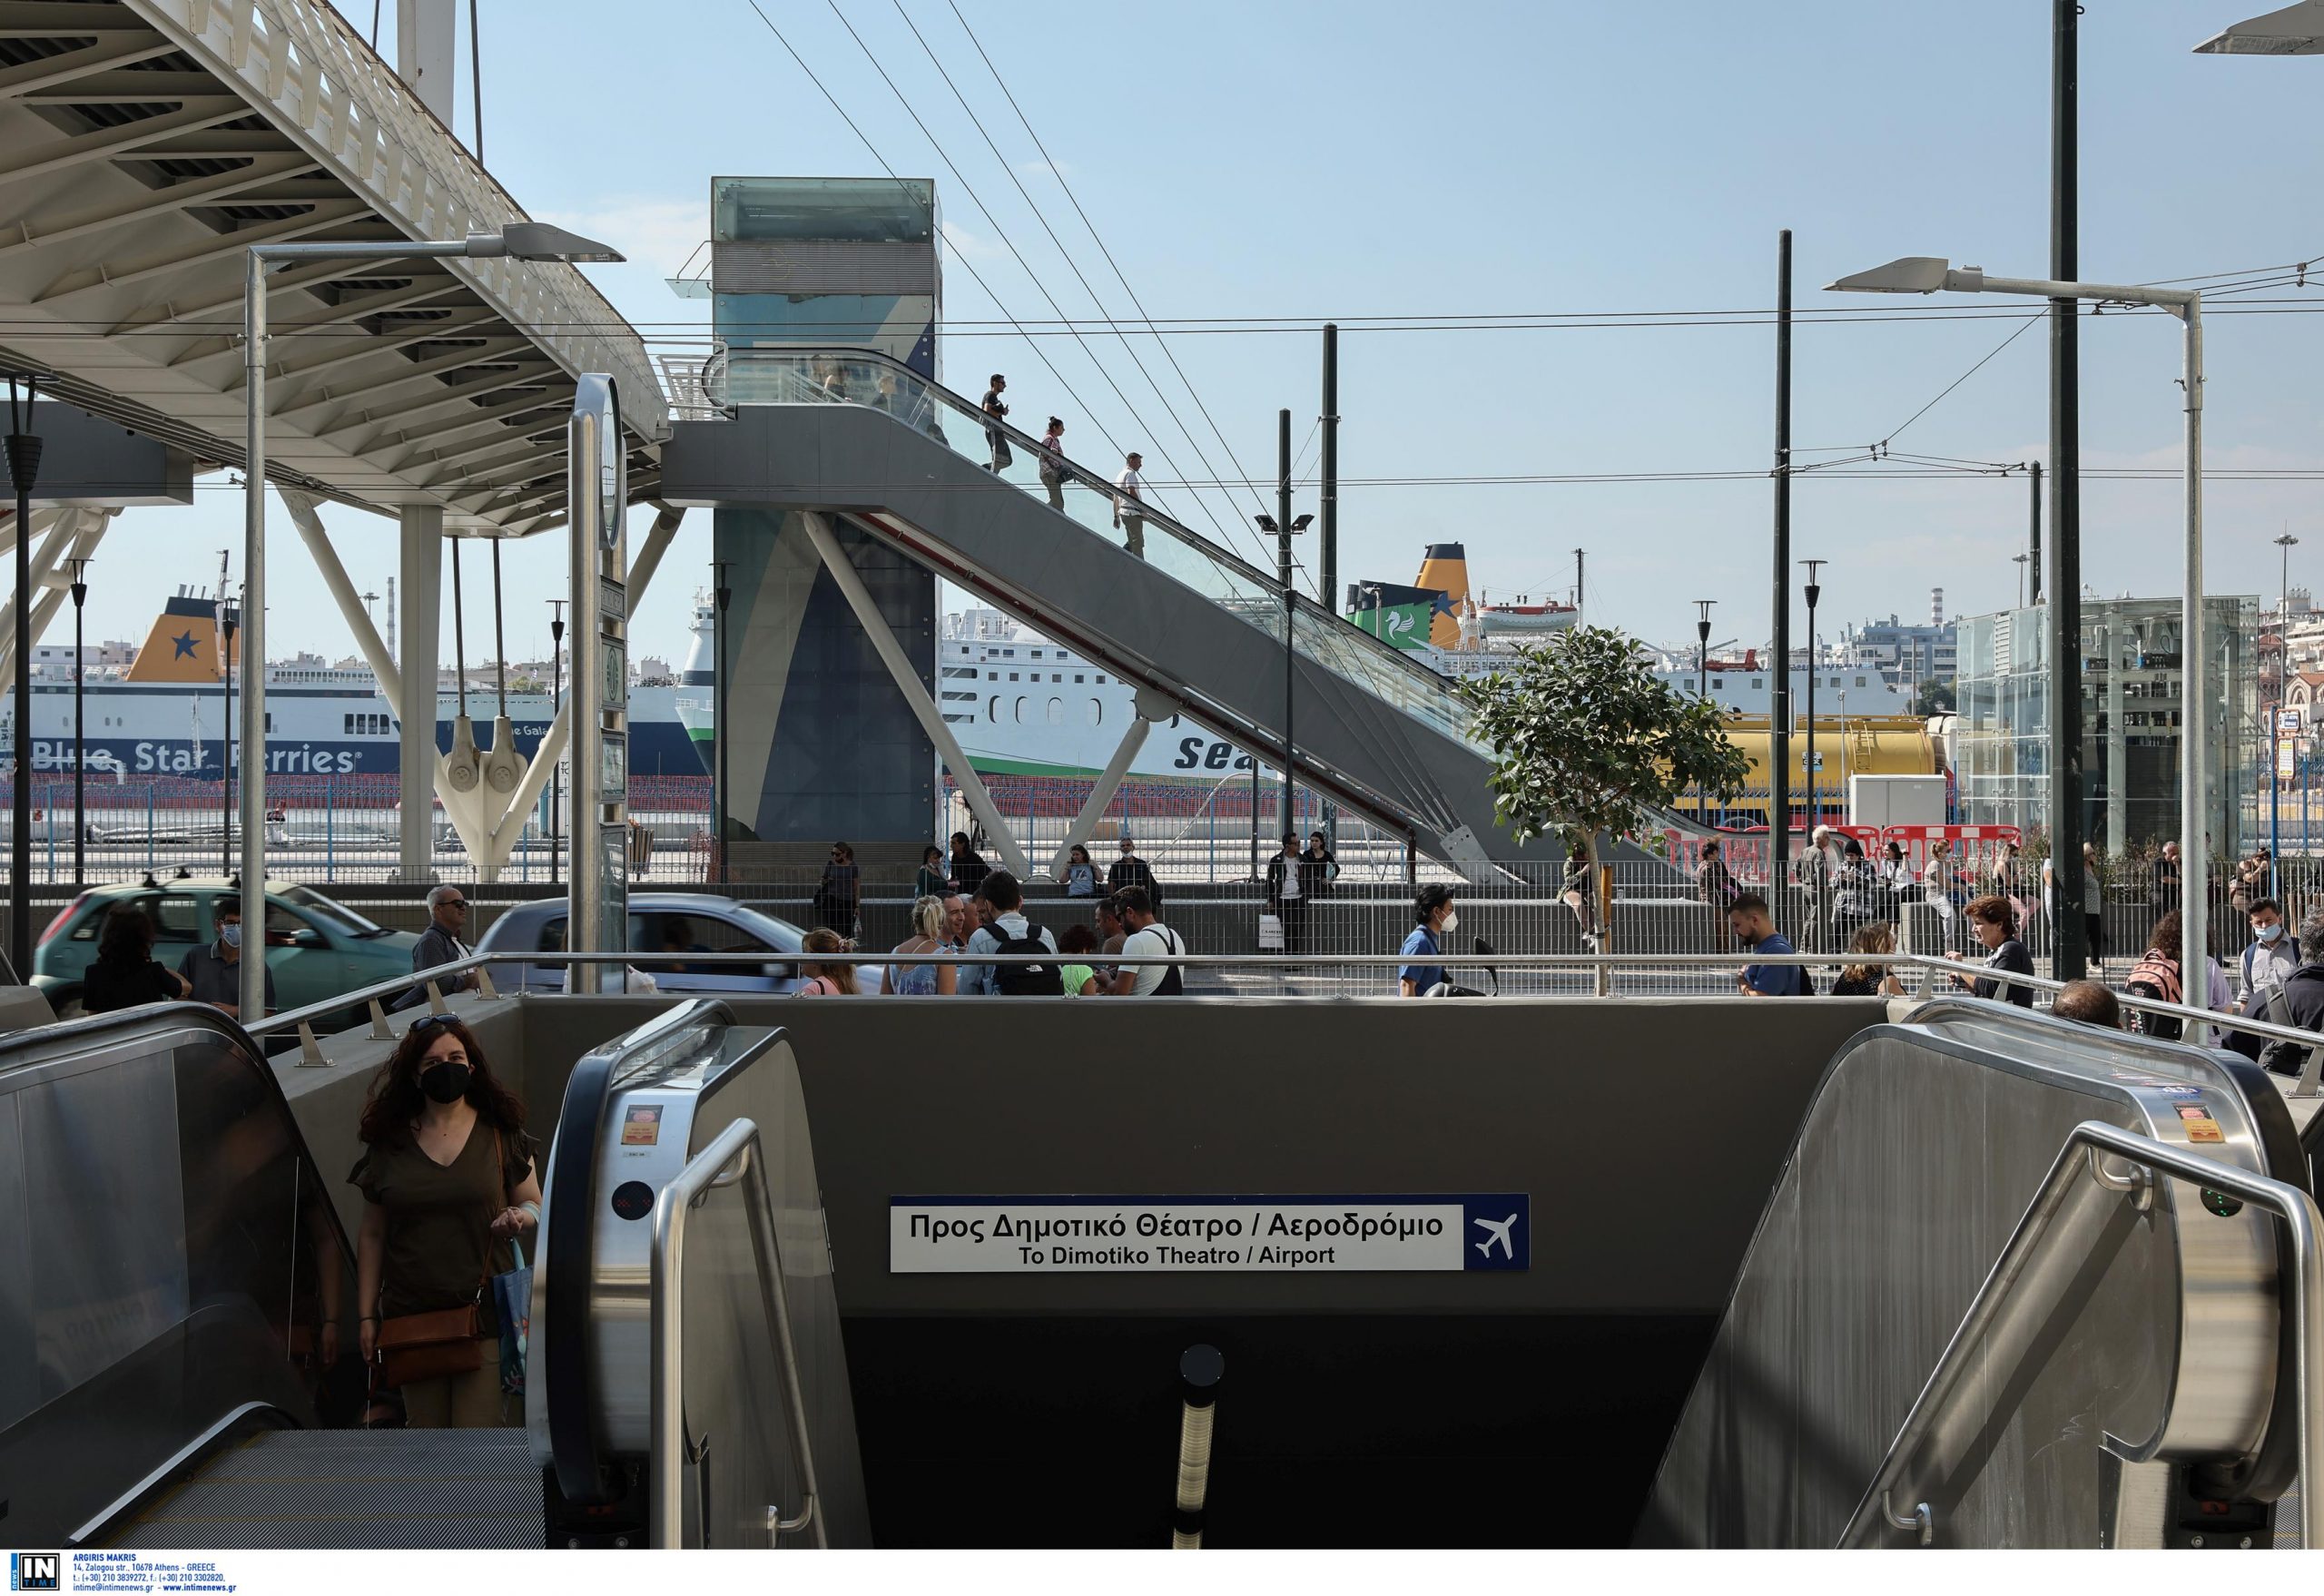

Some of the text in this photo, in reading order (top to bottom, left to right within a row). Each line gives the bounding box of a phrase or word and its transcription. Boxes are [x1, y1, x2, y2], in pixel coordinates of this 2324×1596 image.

[134, 742, 209, 772] Star
[911, 1214, 985, 1244] Προς
[992, 1213, 1127, 1243] Δημοτικό
[1136, 1213, 1243, 1243] Θέατρο
[1266, 1212, 1443, 1242] Αεροδρόμιο
[1018, 1246, 1045, 1265] To
[1052, 1246, 1149, 1265] Dimotiko
[1156, 1246, 1240, 1265] Theatro
[1258, 1246, 1335, 1268] Airport
